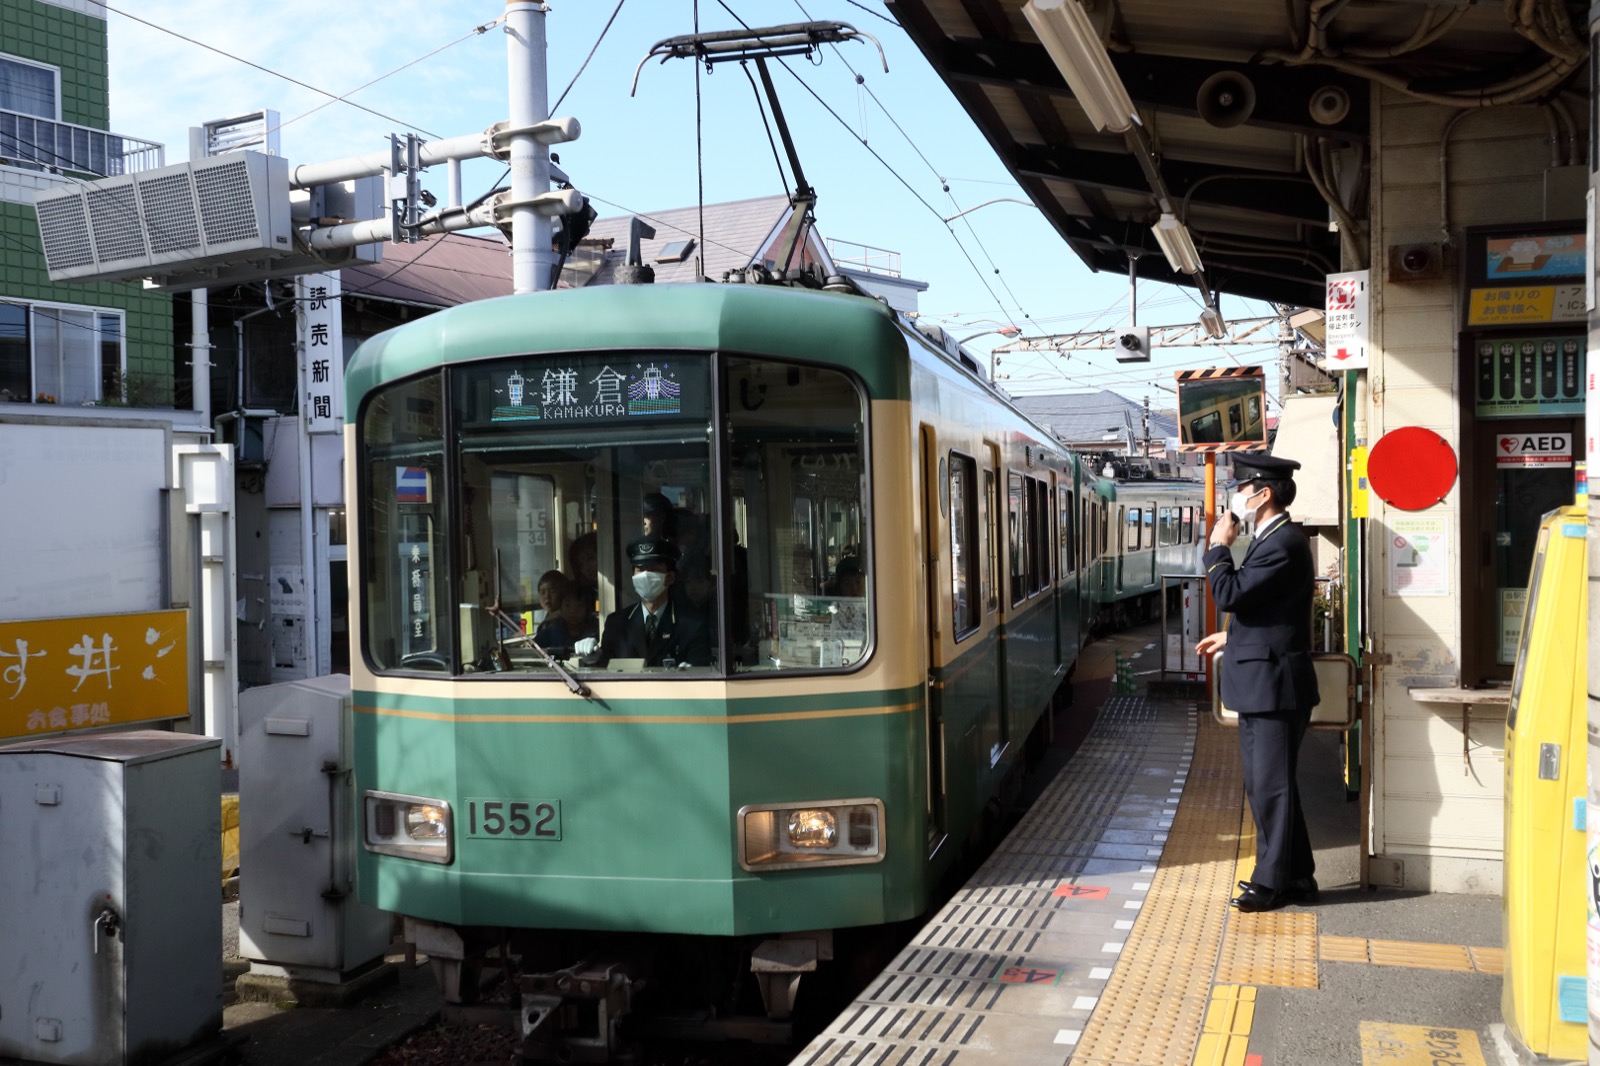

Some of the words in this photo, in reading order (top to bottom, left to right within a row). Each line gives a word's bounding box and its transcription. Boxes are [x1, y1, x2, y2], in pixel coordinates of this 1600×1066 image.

[310, 287, 331, 419] 読売新聞
[541, 365, 627, 406] 鎌倉
[543, 404, 625, 419] KAMAKURA
[1521, 437, 1566, 451] AED
[525, 512, 547, 529] 15
[528, 532, 546, 544] 34
[27, 702, 111, 730] お食事処
[469, 802, 556, 836] 1552
